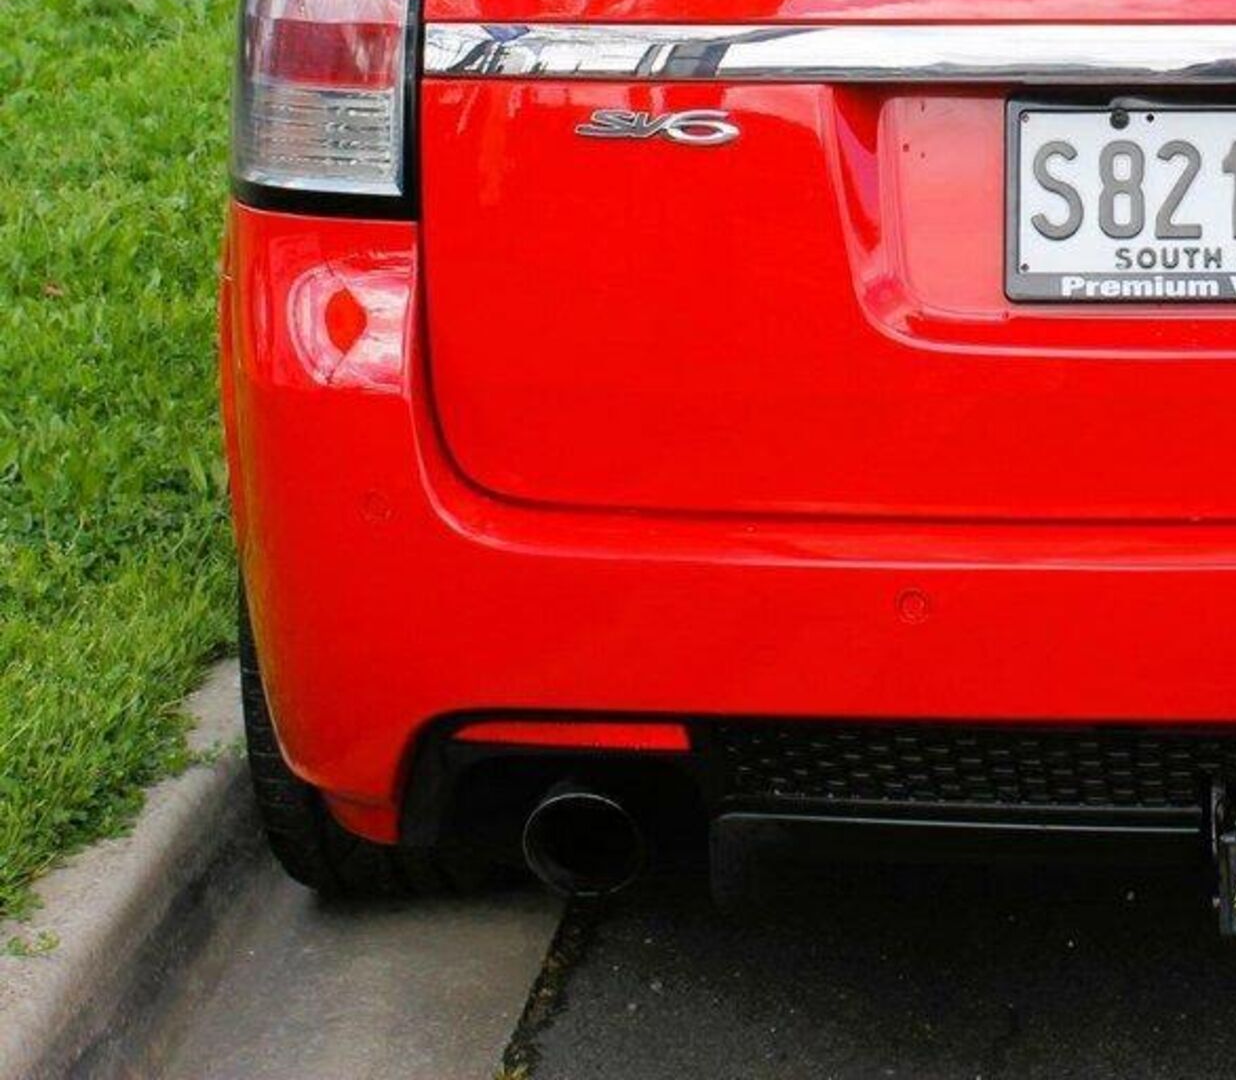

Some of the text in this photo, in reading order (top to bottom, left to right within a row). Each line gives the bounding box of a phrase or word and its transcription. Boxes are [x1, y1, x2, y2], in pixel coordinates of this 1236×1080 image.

[575, 109, 740, 145] SV6
[1114, 247, 1222, 270] SOUTH
[1061, 275, 1224, 297] Premium
